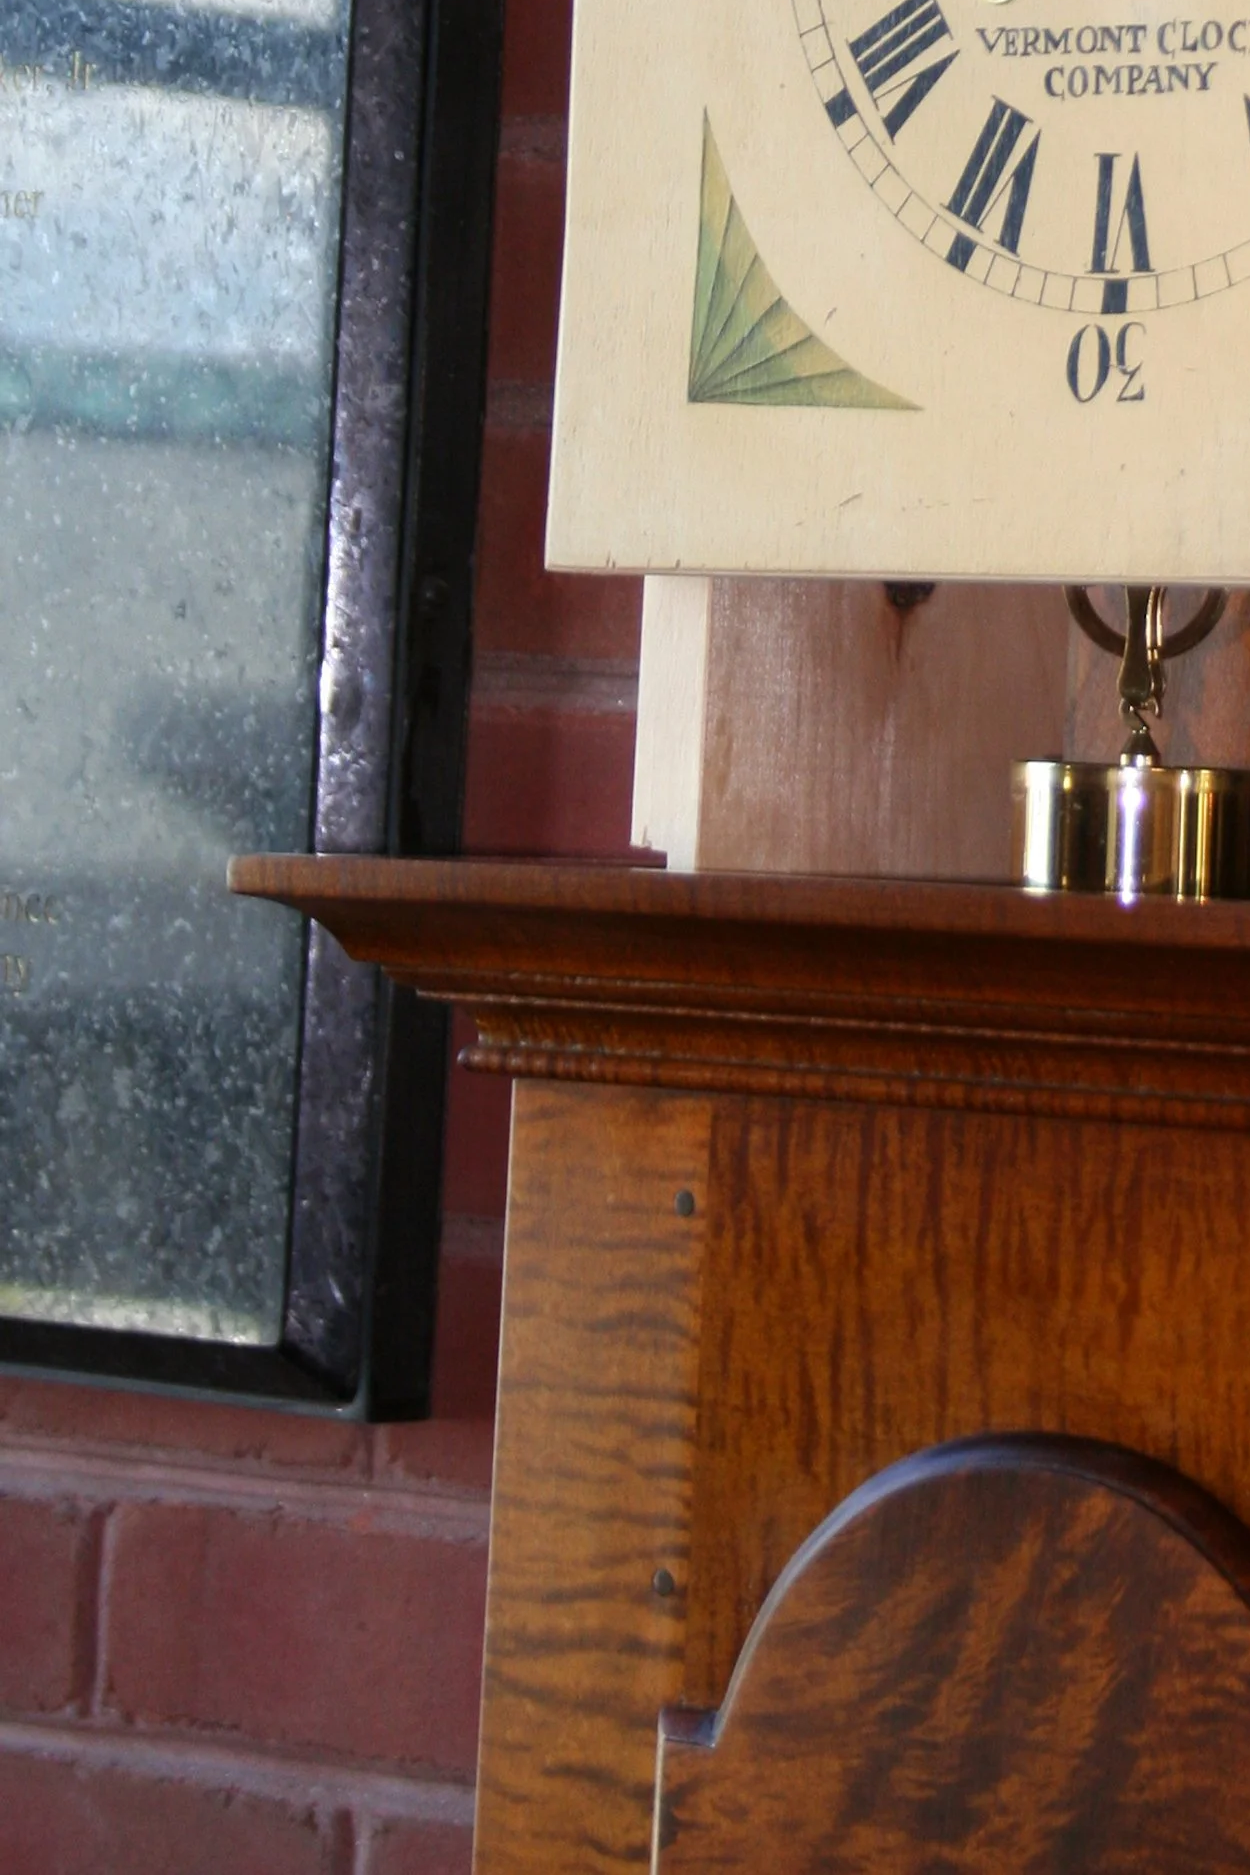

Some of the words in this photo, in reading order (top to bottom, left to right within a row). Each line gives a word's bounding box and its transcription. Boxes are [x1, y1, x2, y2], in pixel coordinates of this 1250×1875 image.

[975, 25, 1147, 56] VERMONT
[1043, 62, 1218, 101] COMPANY
[939, 94, 1042, 258] VII
[1085, 151, 1155, 275] VI
[1066, 321, 1147, 403] 30
